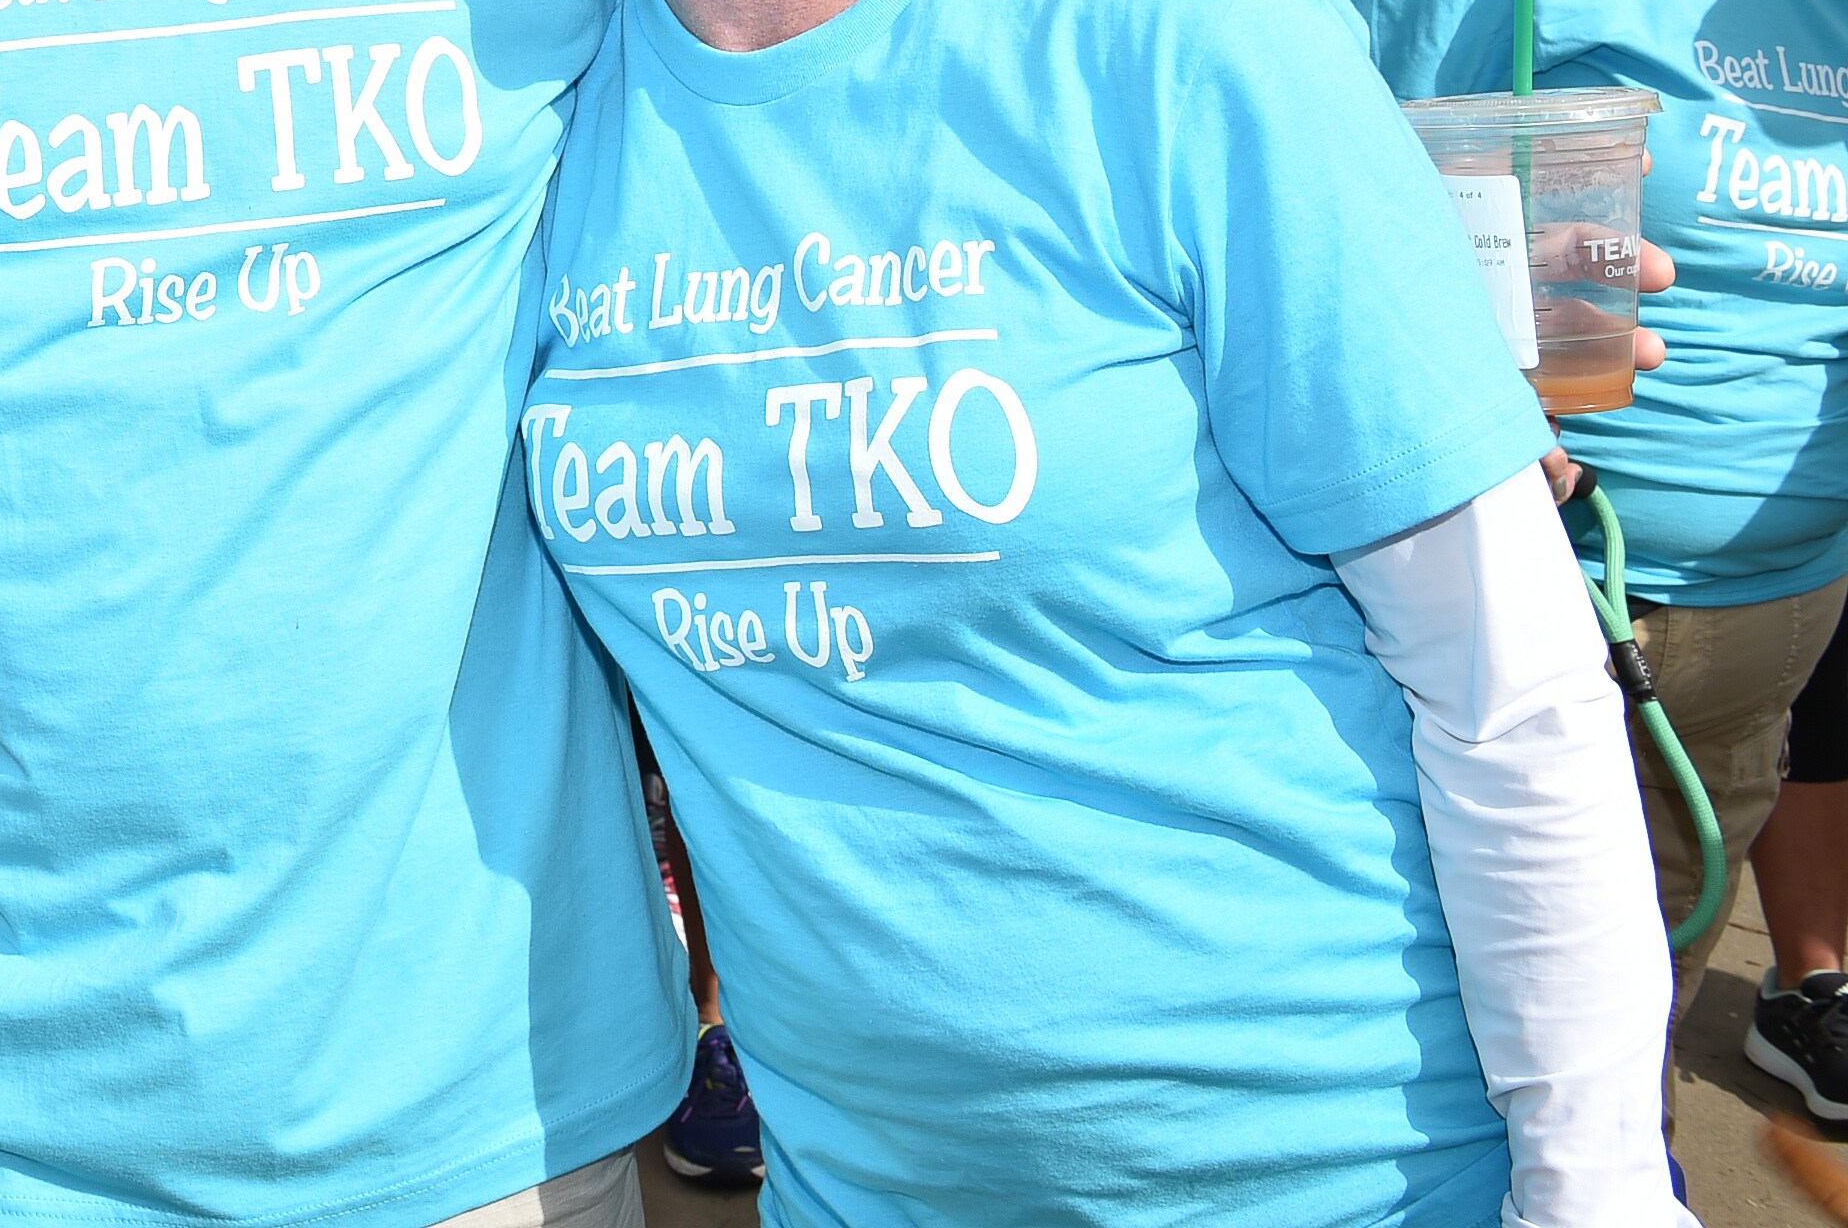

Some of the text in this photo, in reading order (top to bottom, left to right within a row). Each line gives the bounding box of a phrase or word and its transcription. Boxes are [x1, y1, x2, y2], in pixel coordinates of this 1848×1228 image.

[1694, 40, 1774, 91] Beat
[237, 35, 484, 192] TKO
[1696, 113, 1848, 222] Team
[87, 242, 321, 327] Rise Up
[1474, 234, 1491, 249] Cold
[1605, 265, 1625, 278] Our
[1752, 240, 1838, 290] Rise
[549, 231, 995, 348] Beat Lung Cancer
[521, 368, 1038, 542] Team TKO
[651, 581, 874, 682] Rise Up
